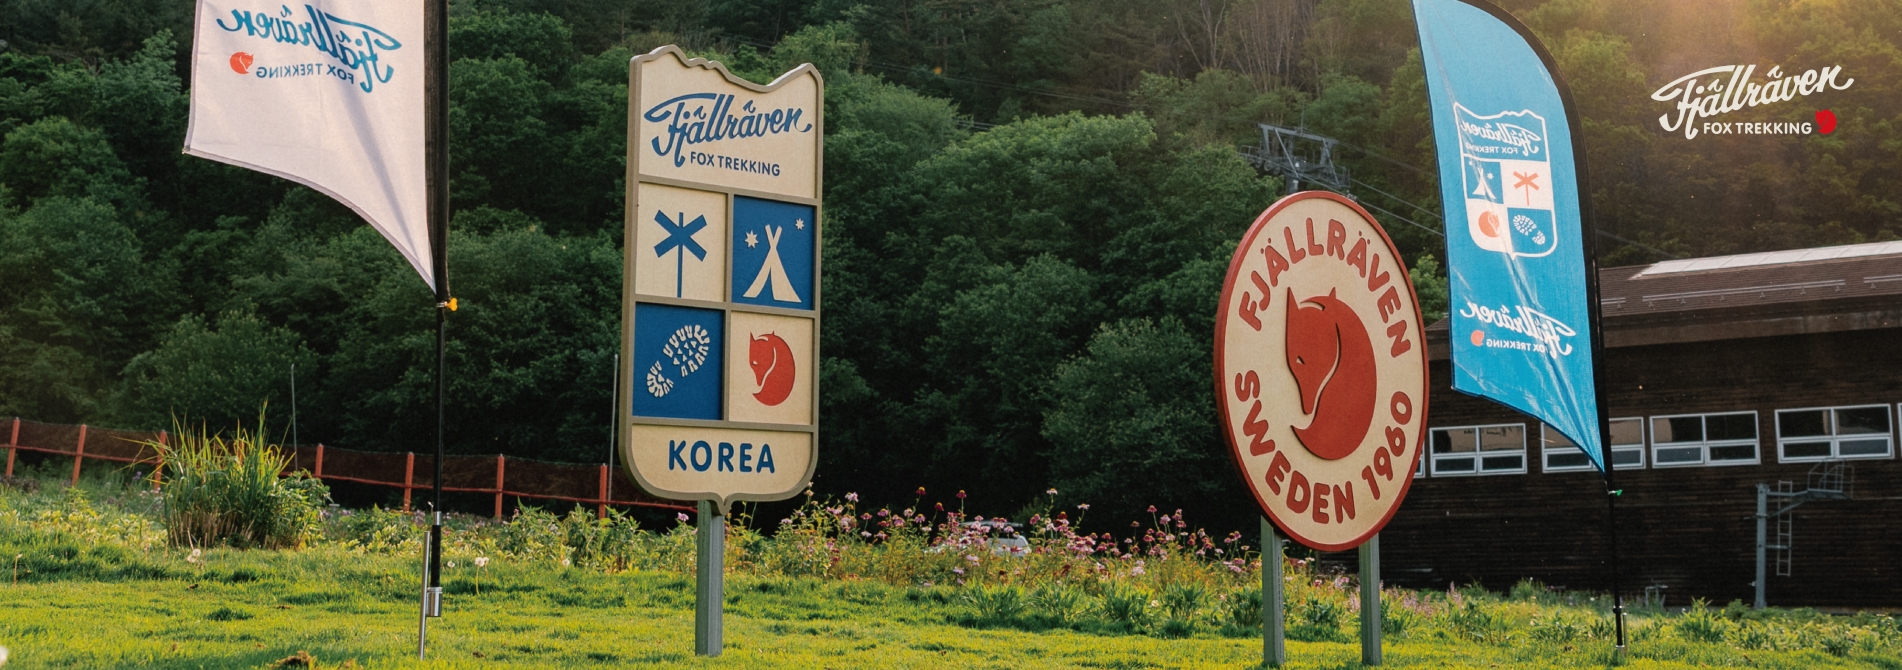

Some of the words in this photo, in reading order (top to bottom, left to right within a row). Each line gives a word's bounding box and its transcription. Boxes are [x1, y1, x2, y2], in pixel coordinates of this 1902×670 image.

[690, 151, 715, 167] FOX
[717, 155, 781, 177] TREKKING
[1239, 217, 1412, 358] FJÄLLRÄVEN
[668, 439, 775, 474] KOREA
[1235, 370, 1356, 525] SWEDEN
[1361, 391, 1412, 501] 1960
